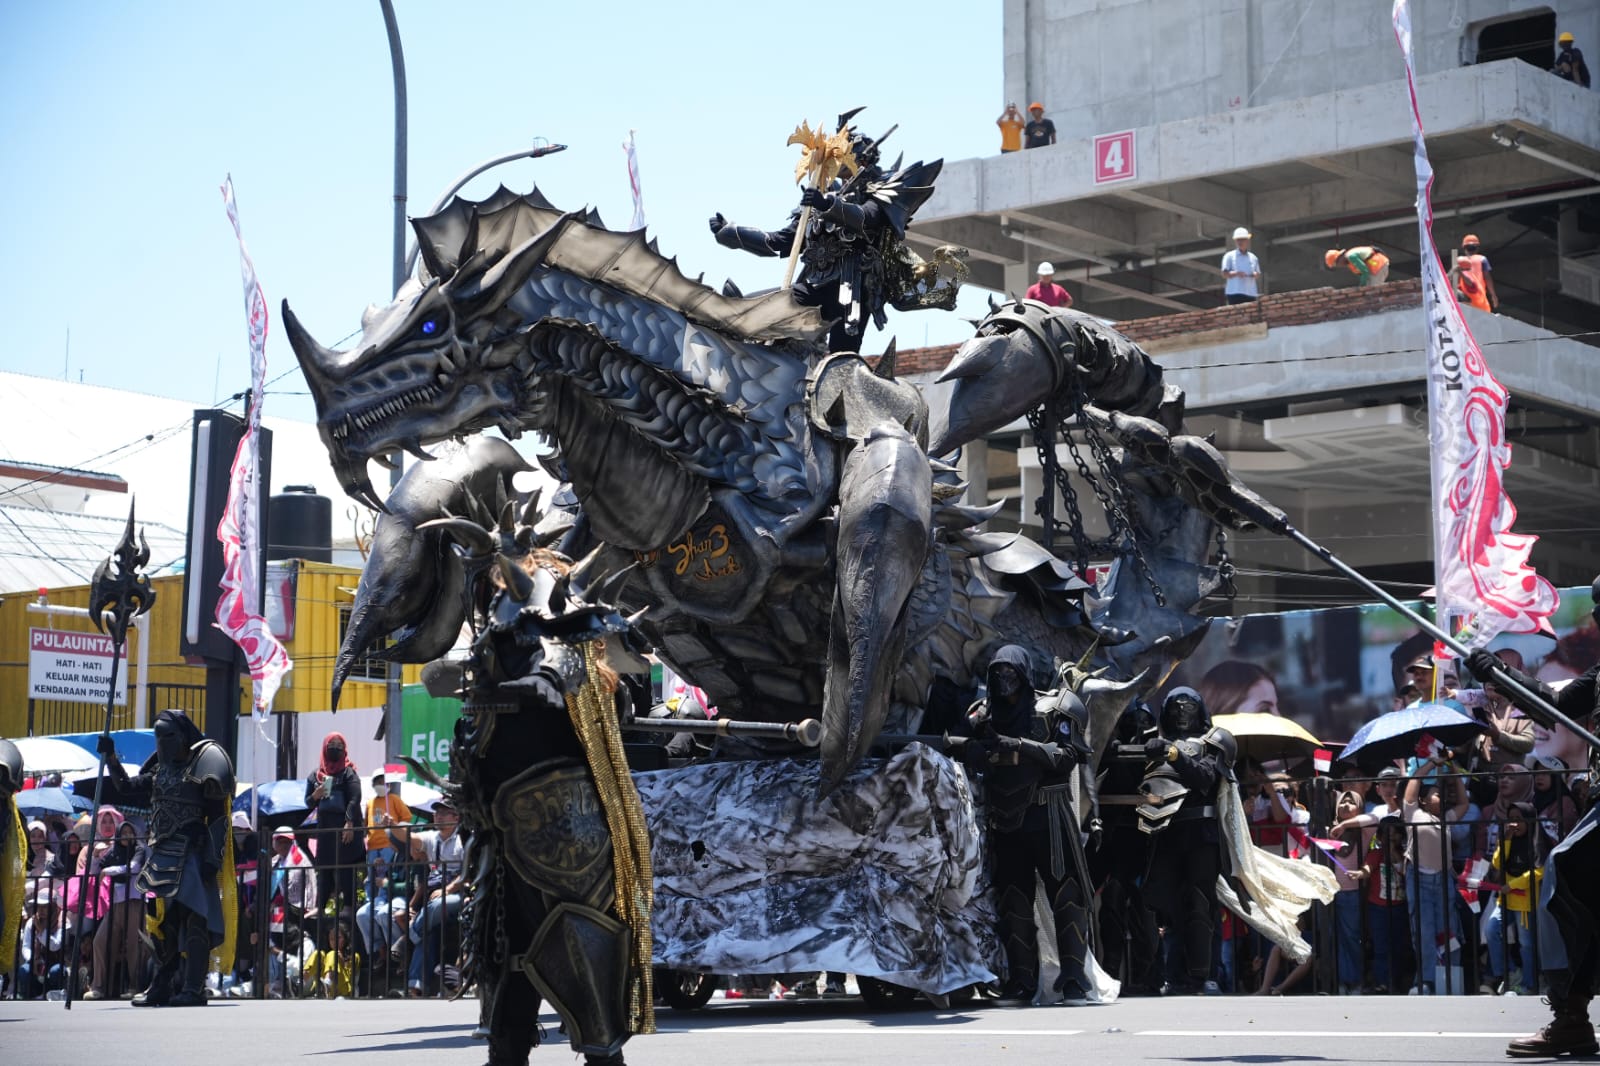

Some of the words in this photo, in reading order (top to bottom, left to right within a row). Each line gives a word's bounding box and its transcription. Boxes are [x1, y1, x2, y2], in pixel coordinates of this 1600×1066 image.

[1104, 140, 1124, 174] 4
[1436, 315, 1463, 391] KOTA
[56, 659, 76, 668] HATI
[82, 661, 102, 671] HATI
[45, 672, 80, 681] KELUAR
[34, 684, 87, 696] KENDARAAN
[89, 690, 122, 699] PROYK
